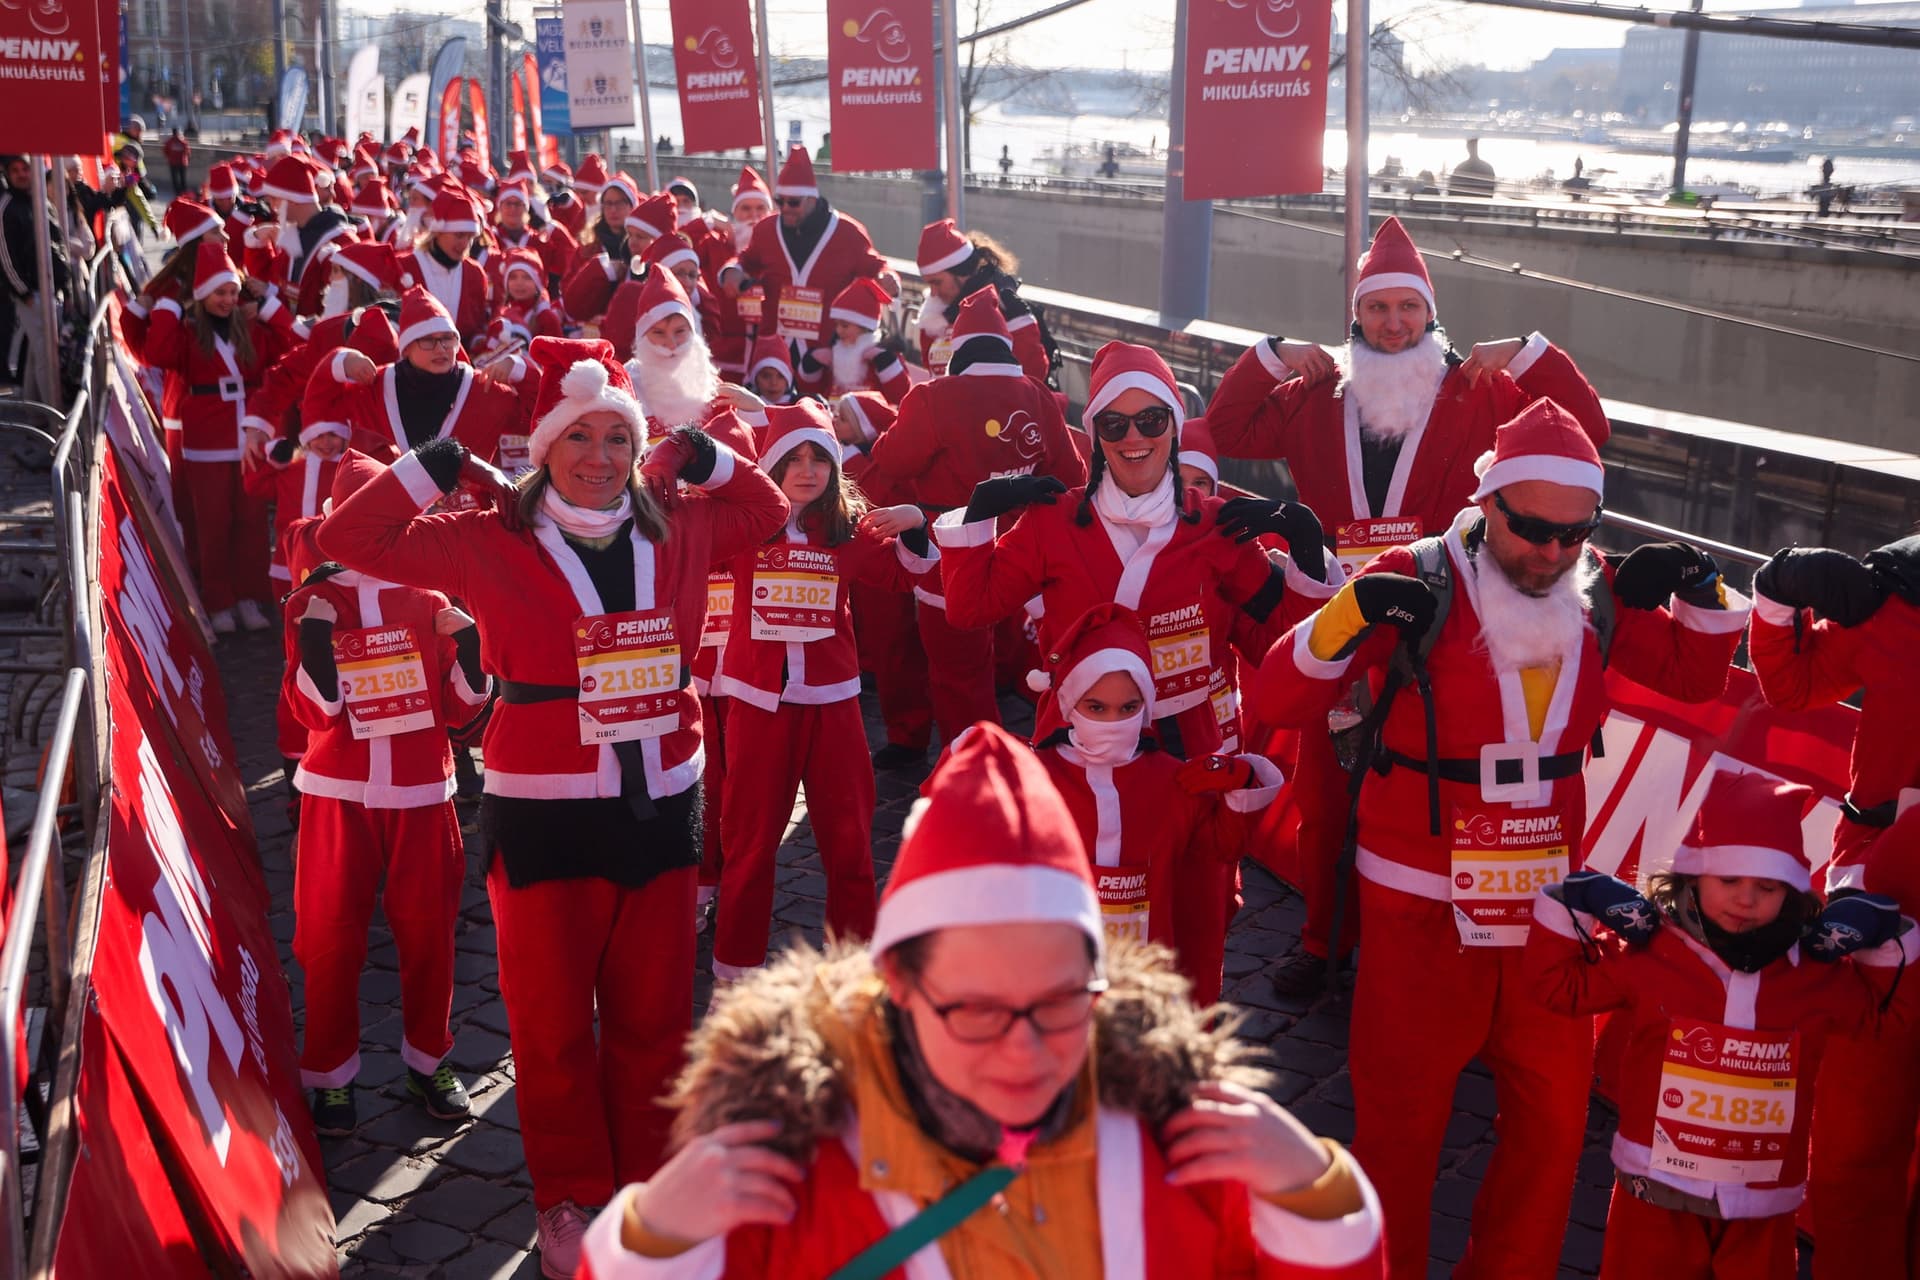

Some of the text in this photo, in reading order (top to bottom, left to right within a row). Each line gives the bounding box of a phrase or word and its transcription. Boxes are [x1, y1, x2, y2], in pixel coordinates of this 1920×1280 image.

[1203, 45, 1312, 75] PENNY.
[0, 63, 86, 82] IKULÁSFUTÁS
[686, 69, 749, 90] PENNY.
[842, 66, 922, 88] PENNY.
[842, 89, 922, 106] MIKULÁSFUTÁS
[1202, 79, 1311, 101] MIKULÁSFUTÁS
[1369, 521, 1419, 535] PENNY.
[1369, 533, 1419, 544] MIKULÁSFUTÁS
[787, 560, 835, 572] MIKULÁSFUTÁS
[788, 549, 834, 565] PENNY.
[770, 584, 831, 606] 21302
[1150, 603, 1203, 628] PENNY.
[615, 616, 673, 637] PENNY.
[1149, 616, 1205, 637] MIKULÁSFUTÁS
[365, 628, 412, 647] PENNY.
[616, 631, 675, 647] MIKULÁSFUTÁS
[366, 641, 414, 656] MIKULÁSFUTÁS
[353, 668, 419, 697] 21303
[601, 663, 675, 694] 21813
[1501, 815, 1562, 834] PENNY.
[1500, 832, 1562, 846] MIKULÁSFUTÁS
[1098, 873, 1147, 890] PENNY.
[1478, 866, 1560, 894] 21831
[1721, 1038, 1792, 1060] PENNY.
[1720, 1056, 1791, 1073] MIKULÁSFUTÁS
[1686, 1088, 1786, 1127] 21834
